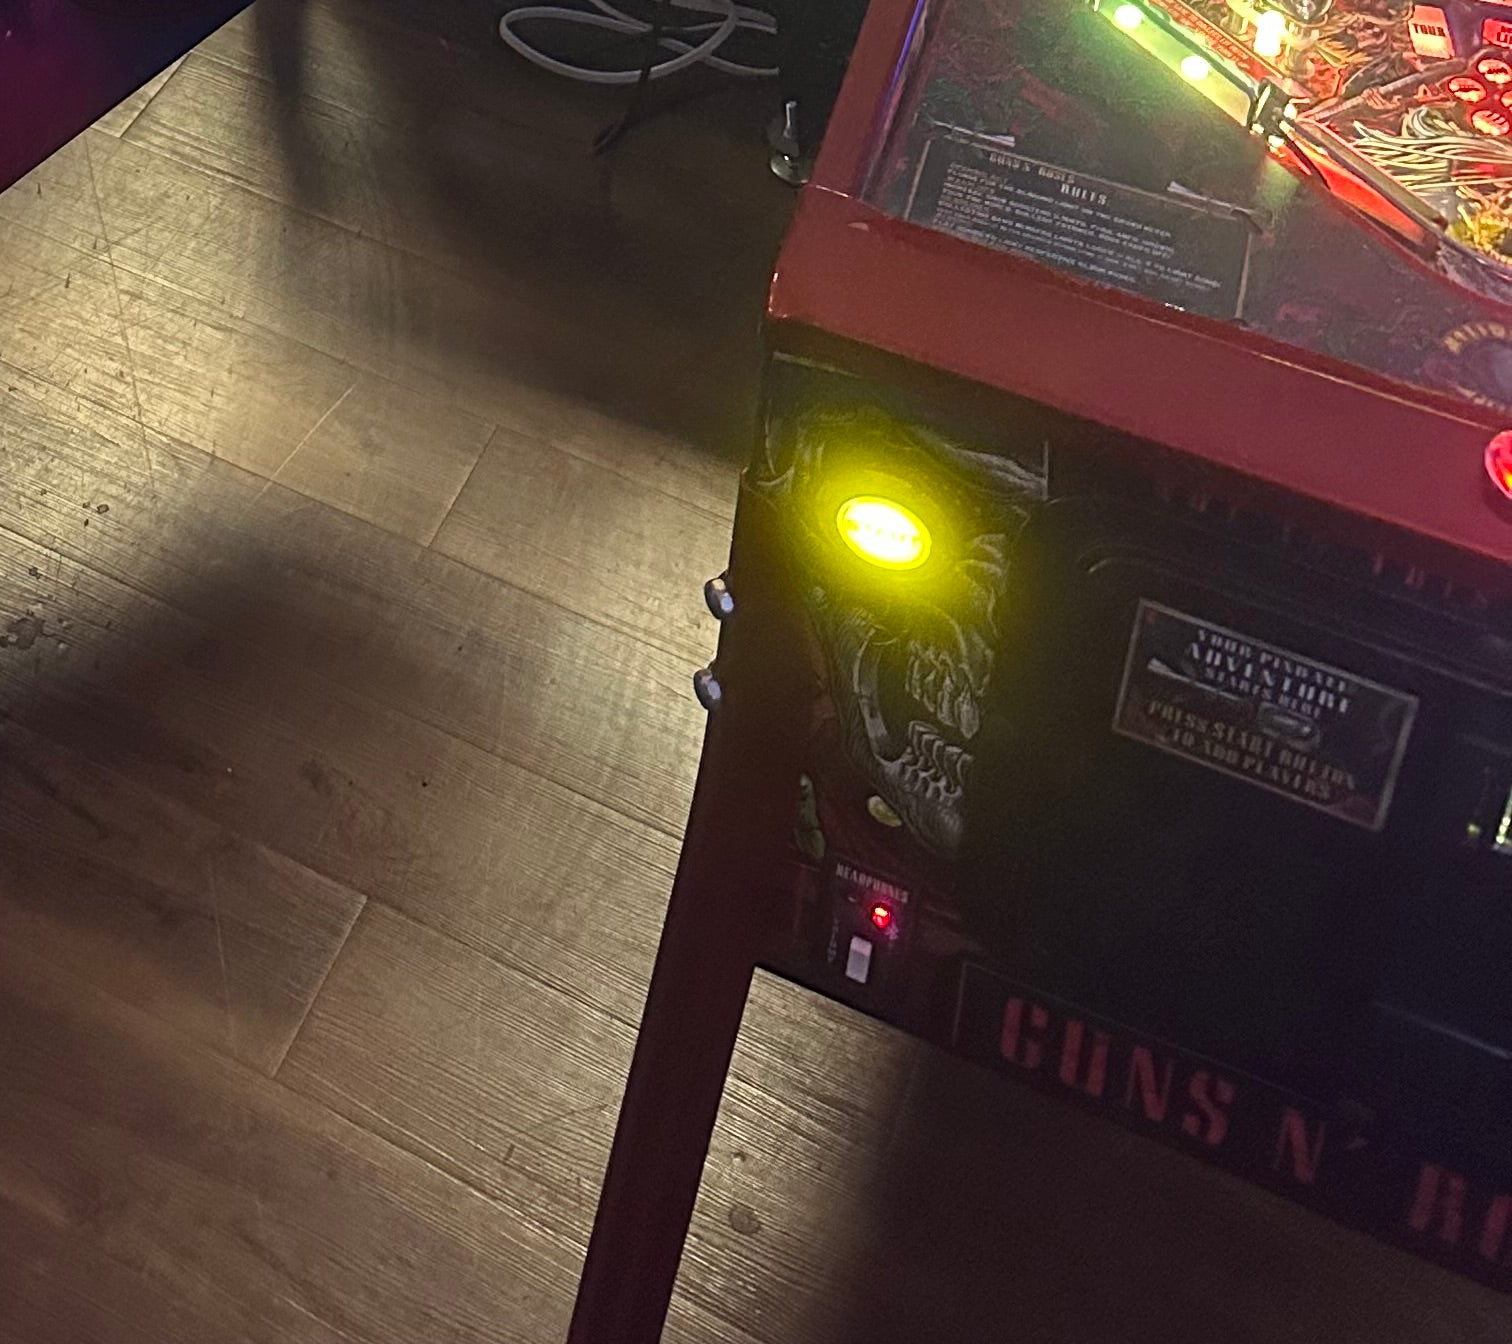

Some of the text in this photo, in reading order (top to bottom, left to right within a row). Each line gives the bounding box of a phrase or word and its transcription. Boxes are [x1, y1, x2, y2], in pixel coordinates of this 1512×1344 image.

[1413, 22, 1447, 38] TOUR
[1059, 183, 1109, 207] RULES
[1000, 995, 1236, 1147] GUNS
